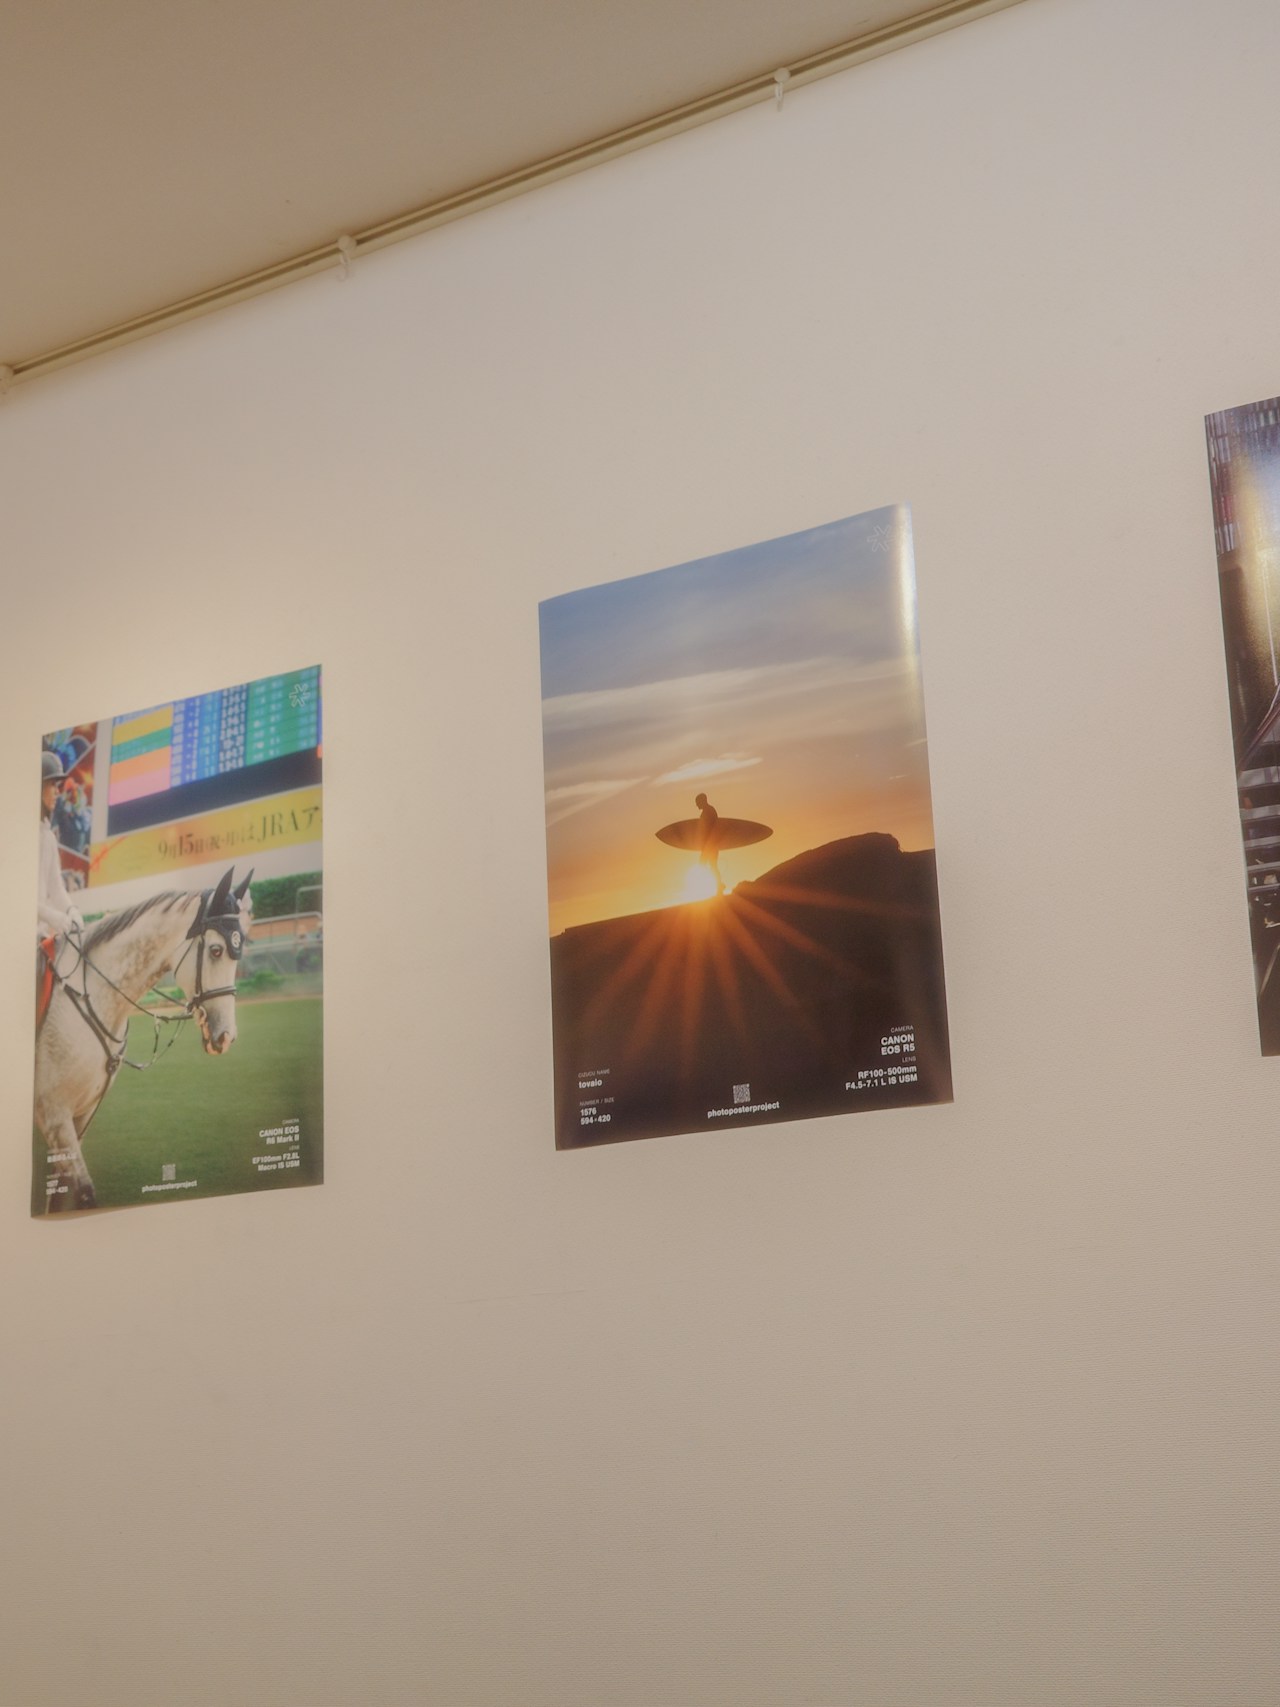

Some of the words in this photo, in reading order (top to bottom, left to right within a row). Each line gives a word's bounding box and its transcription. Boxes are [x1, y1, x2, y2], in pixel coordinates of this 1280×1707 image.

[890, 1025, 913, 1033] CAMERA
[881, 1033, 914, 1045] CANON
[881, 1045, 900, 1055] EOS
[903, 1043, 915, 1053] R5
[858, 1066, 917, 1079] RF100-500mm
[845, 1079, 878, 1091] F4.5-7.1
[881, 1078, 886, 1086] L
[888, 1076, 897, 1085] IS
[899, 1073, 918, 1083] USM
[580, 1107, 597, 1116] 1576
[707, 1101, 780, 1119] photoposterproject
[259, 1127, 284, 1137] CANON
[285, 1125, 300, 1134] EOS
[277, 1135, 293, 1144] Mark
[142, 1180, 197, 1193] photoposterproject
